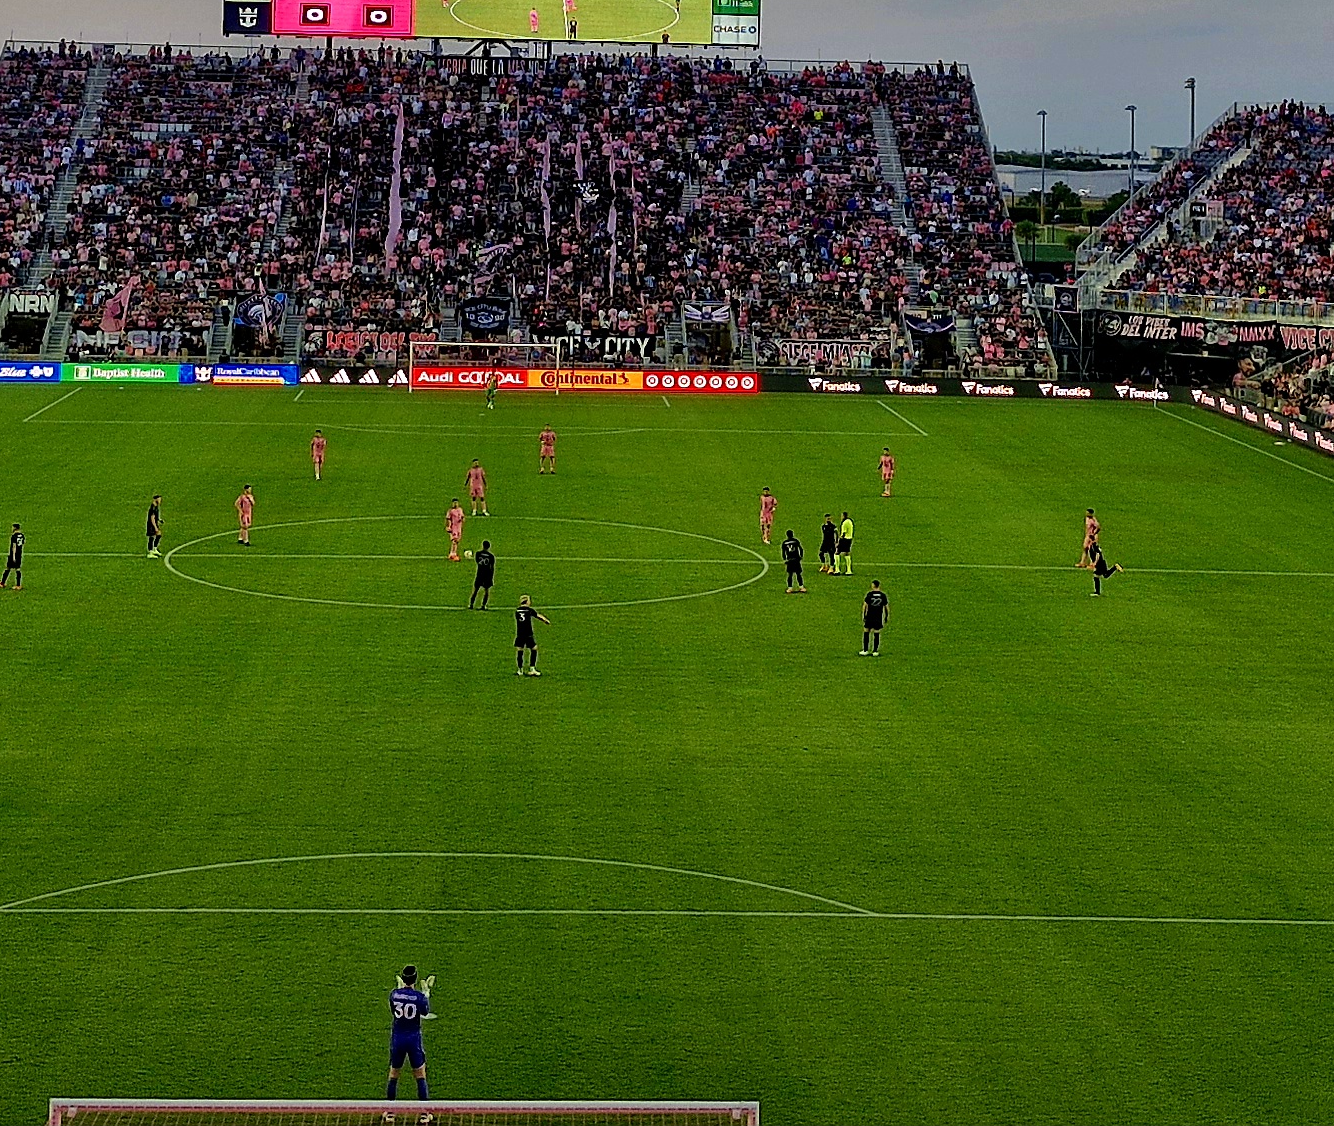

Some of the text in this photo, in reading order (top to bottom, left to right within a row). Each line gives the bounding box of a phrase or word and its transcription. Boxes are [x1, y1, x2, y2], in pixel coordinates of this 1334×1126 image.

[306, 7, 324, 21] 0
[370, 10, 388, 23] 0
[713, 25, 747, 34] CHASE
[10, 294, 55, 313] NRN
[1120, 324, 1178, 340] DEL INTER
[1280, 326, 1316, 351] VICE
[605, 337, 651, 358] CITY
[93, 367, 165, 379] Baptist Health
[418, 371, 453, 382] Audi
[540, 371, 617, 387] Continental
[822, 380, 861, 392] Fanatics
[898, 382, 938, 394] Fanatics
[975, 383, 1014, 396] Fanatics
[1052, 385, 1091, 398] Fanatics
[1129, 387, 1169, 400] Fanatics
[478, 556, 490, 566] 20
[518, 612, 526, 622] 3
[393, 1001, 417, 1020] 30
